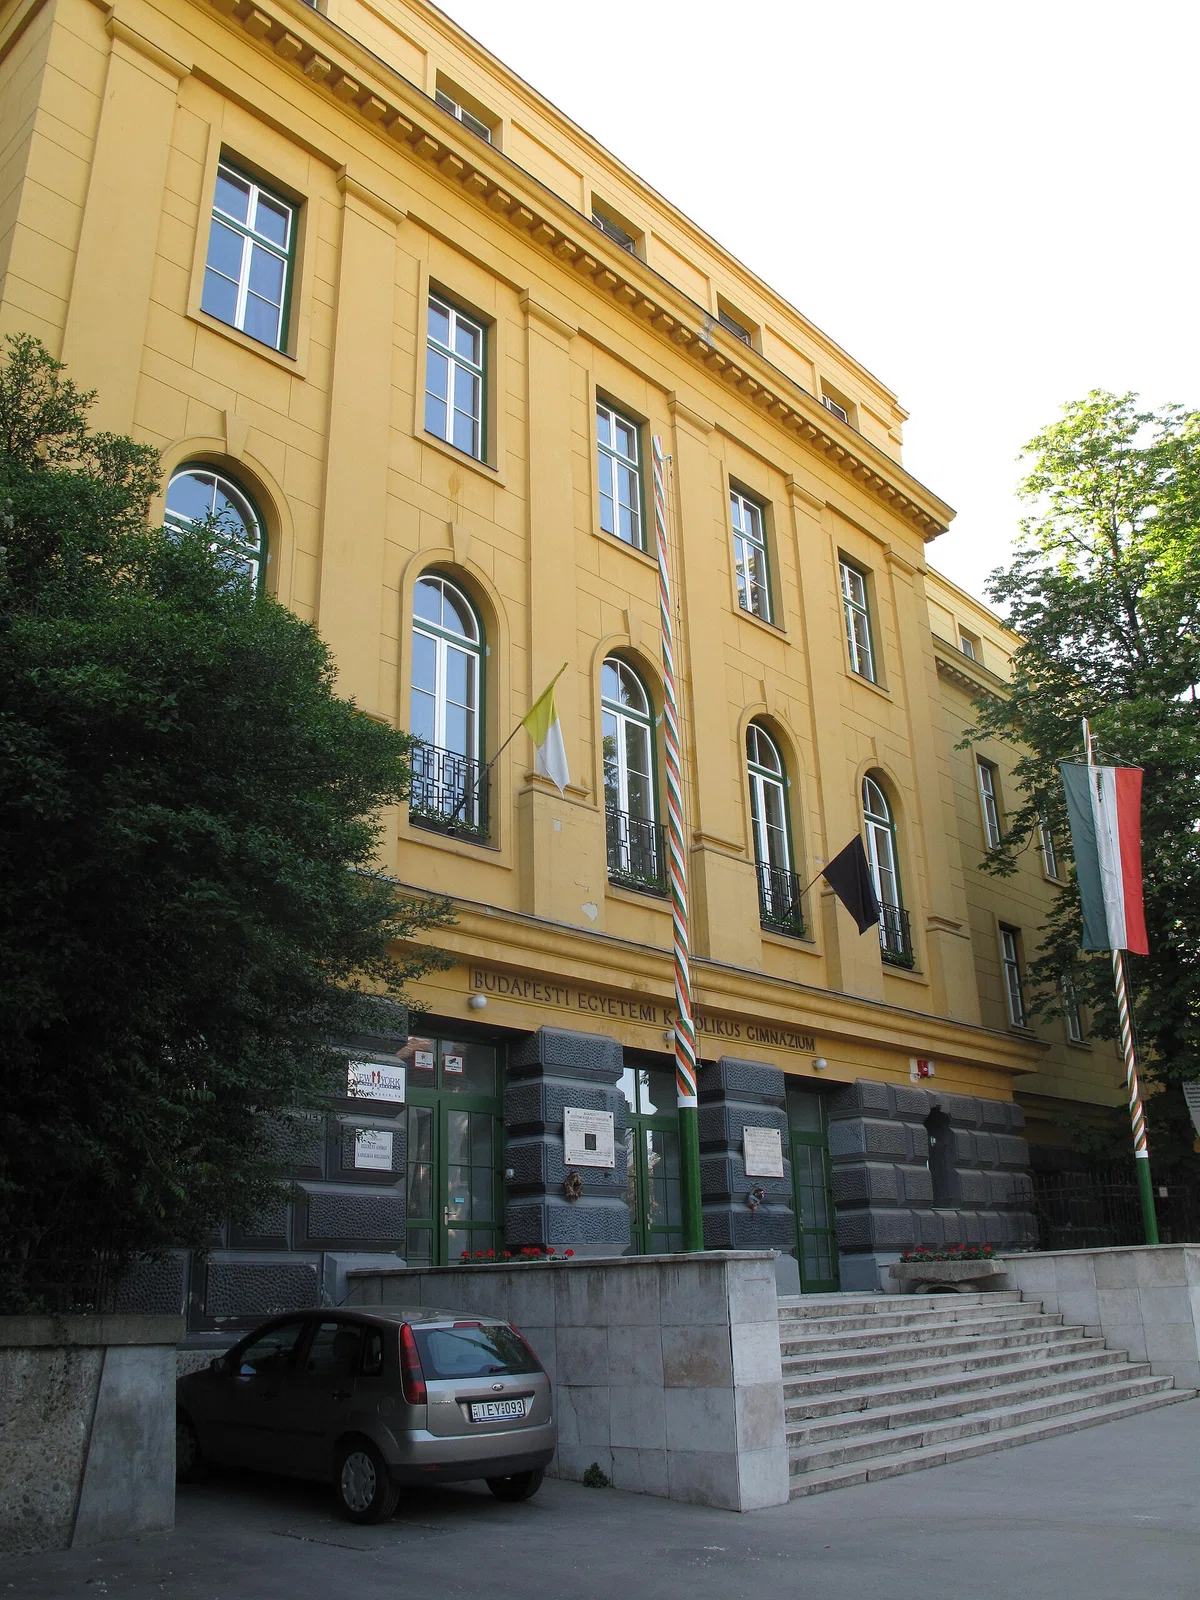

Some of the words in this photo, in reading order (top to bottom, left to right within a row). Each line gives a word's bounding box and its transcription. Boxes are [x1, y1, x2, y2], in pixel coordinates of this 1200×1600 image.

[474, 970, 570, 1006] BUDAPESTI
[578, 992, 657, 1022] EGYETEMI
[663, 1009, 741, 1038] KOLIKUS
[746, 1026, 815, 1052] GIMNÁZIUM
[380, 1076, 401, 1086] YORK
[481, 1401, 523, 1416] IEY-093
